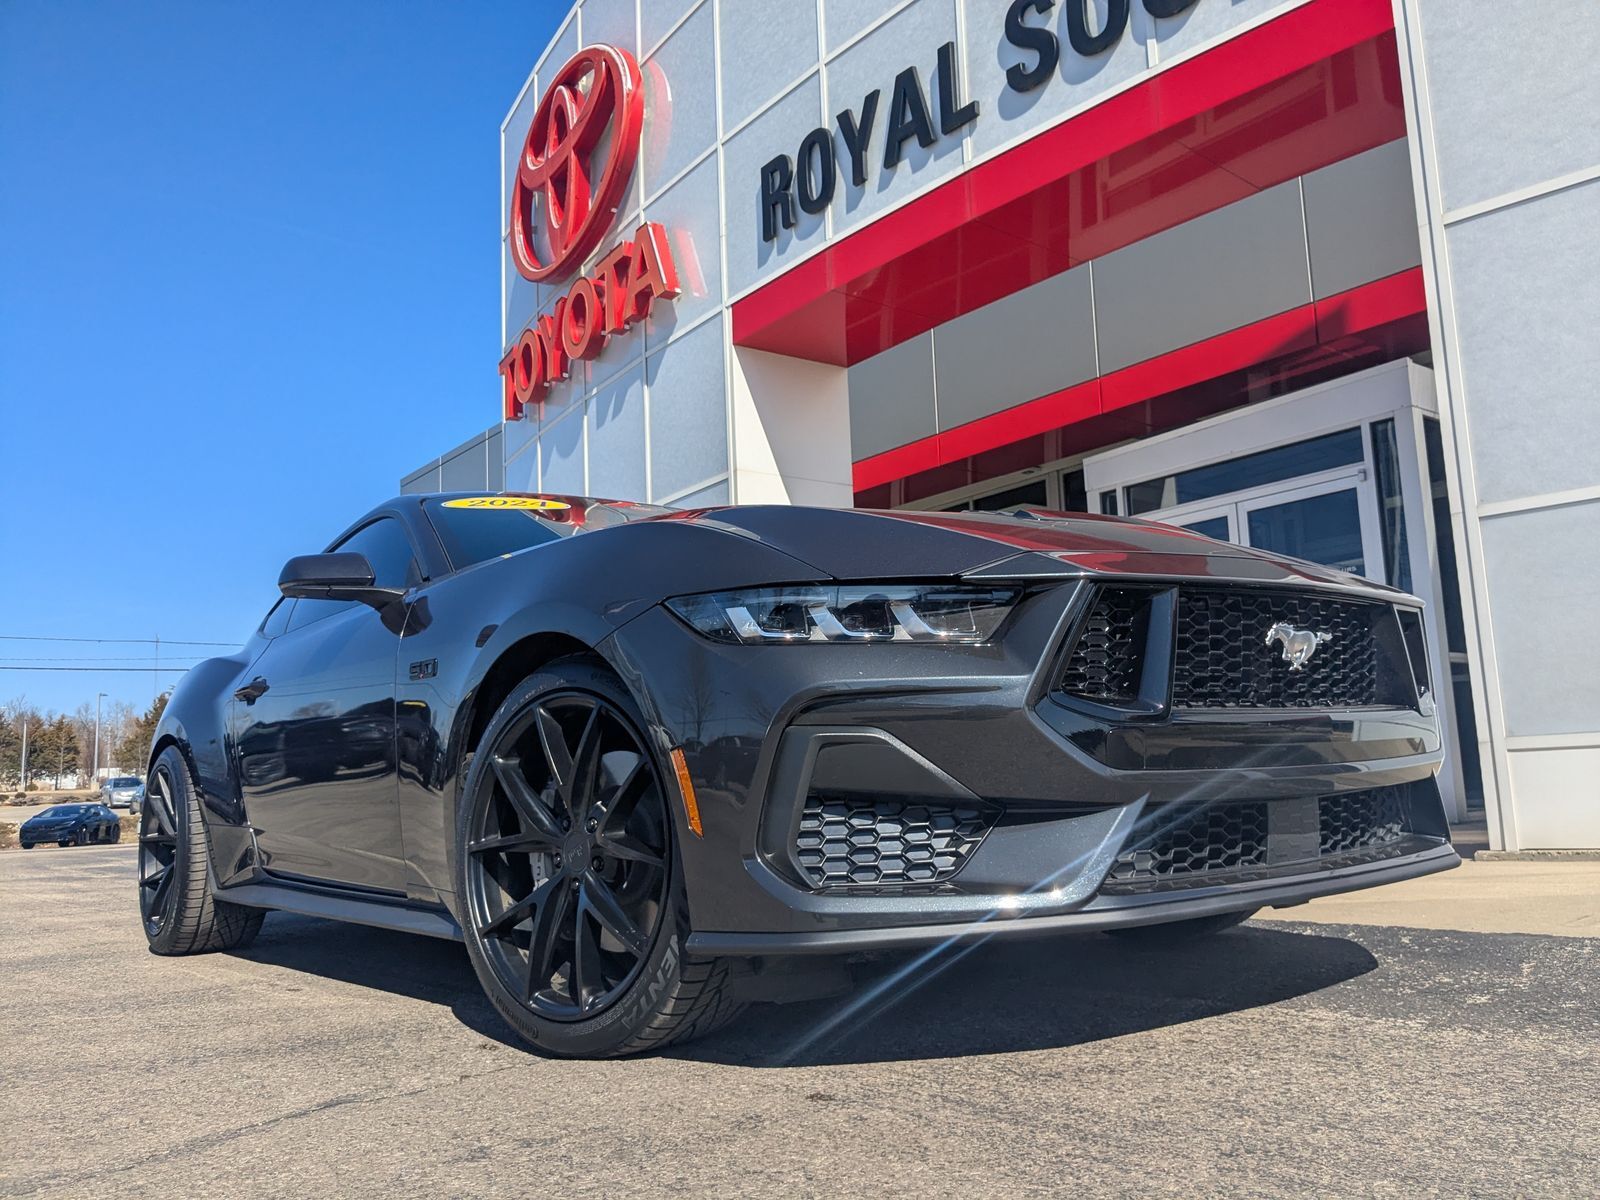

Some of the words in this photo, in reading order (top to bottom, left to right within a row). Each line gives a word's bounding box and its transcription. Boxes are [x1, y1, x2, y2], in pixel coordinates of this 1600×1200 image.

[760, 41, 980, 242] ROYAL
[498, 221, 682, 421] TOYOTA
[468, 499, 548, 508] 2024
